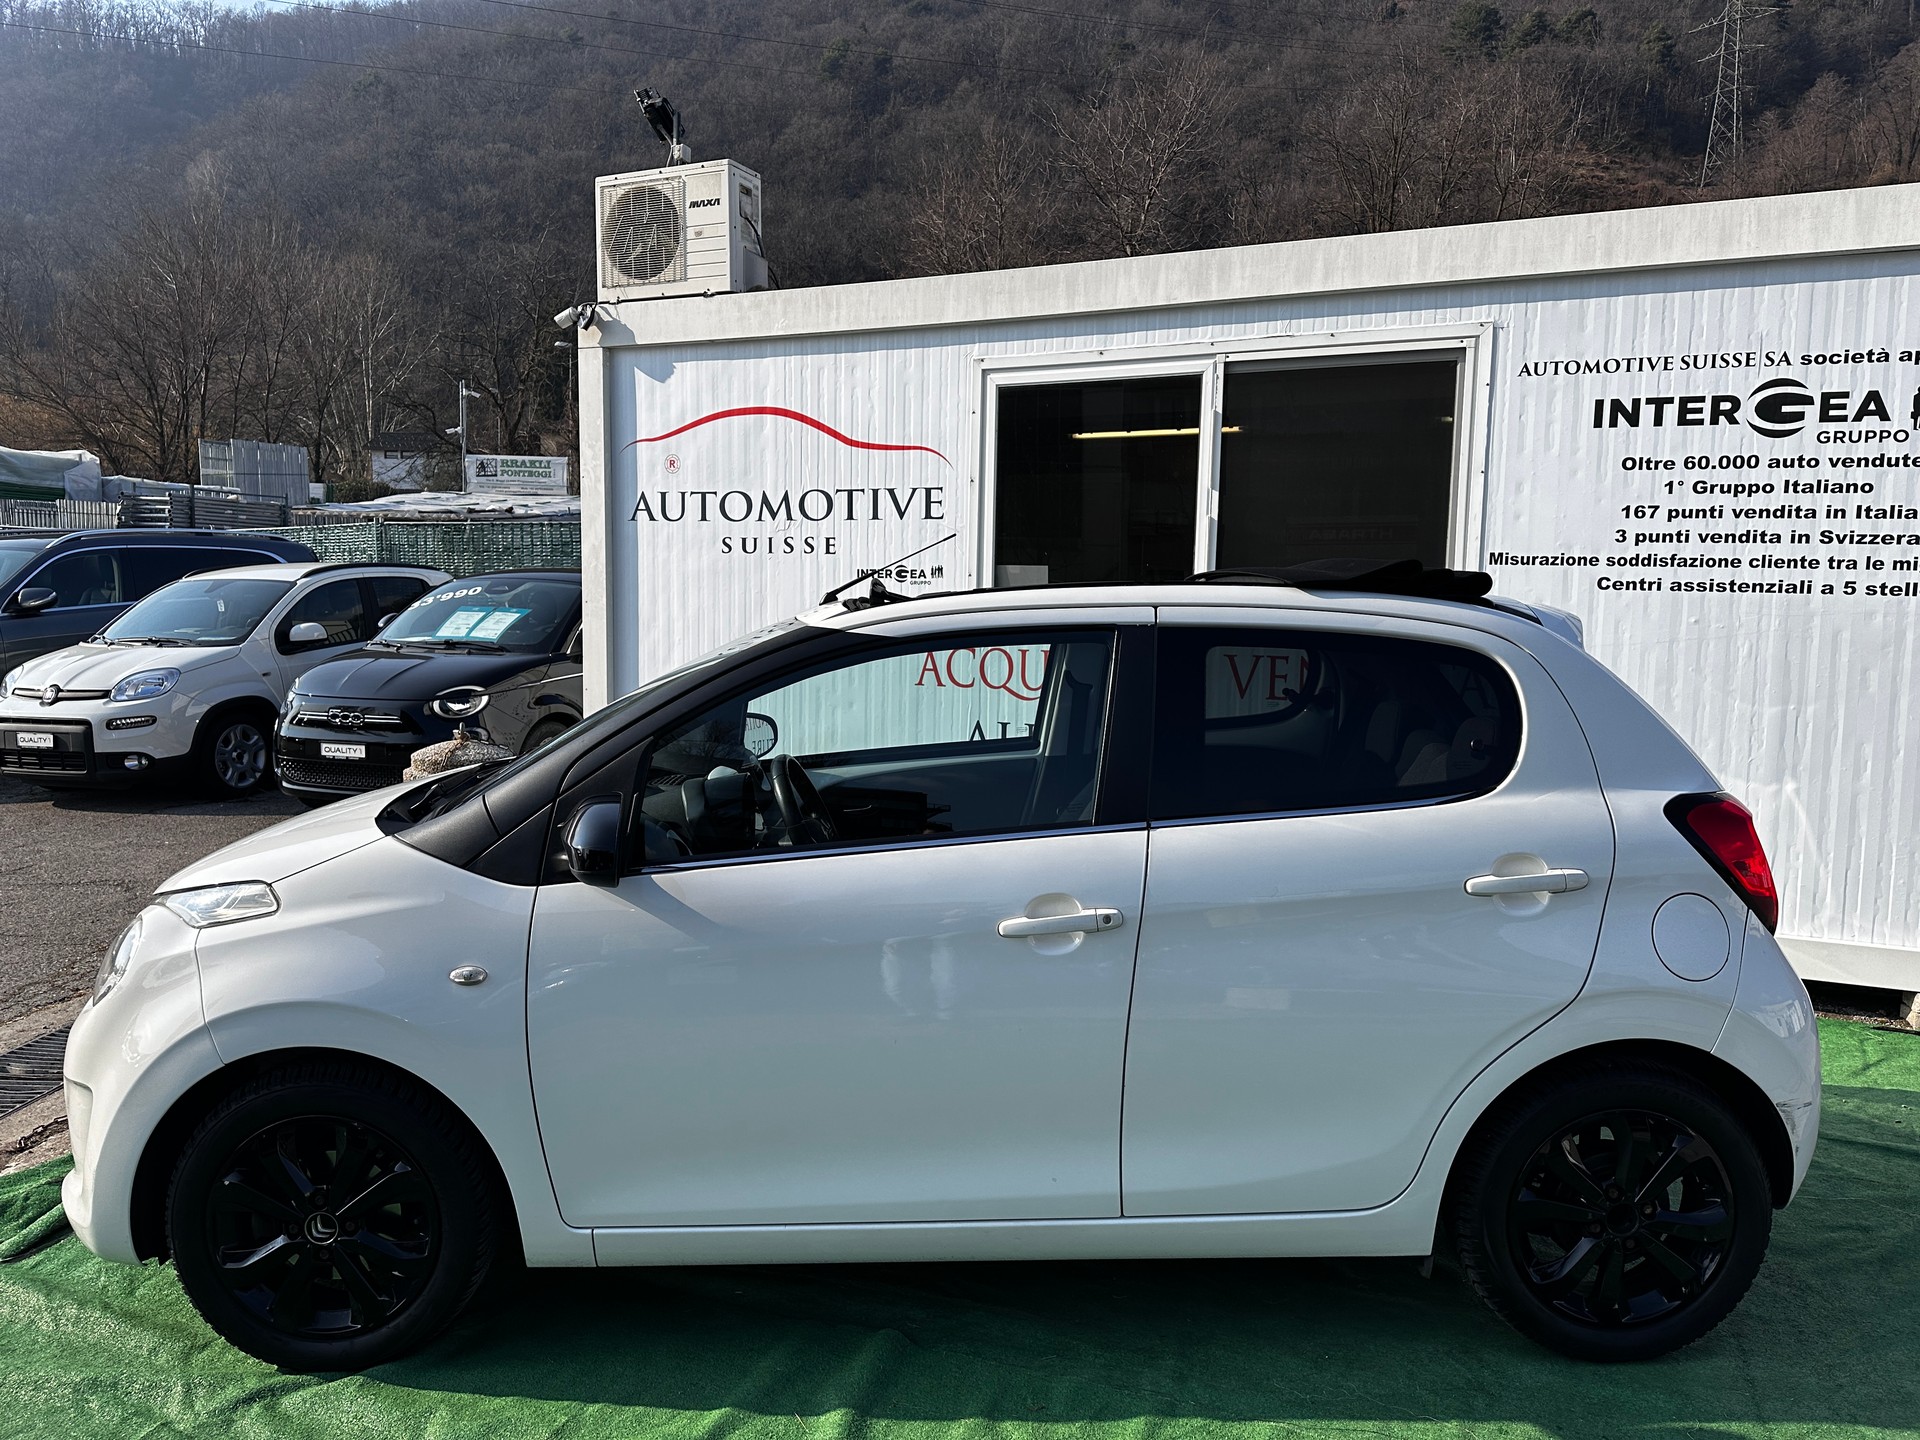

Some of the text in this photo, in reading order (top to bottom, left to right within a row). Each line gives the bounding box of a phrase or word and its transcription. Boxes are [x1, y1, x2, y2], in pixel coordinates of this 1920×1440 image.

[688, 198, 721, 209] MAXA
[1517, 355, 1674, 377] AUTOMOTIVE
[1679, 351, 1757, 371] SUISSE
[1763, 350, 1793, 368] SA
[1800, 347, 1890, 366] società
[1593, 380, 1892, 438] INTERGEA
[1816, 429, 1910, 444] GRUPPO
[500, 459, 552, 469] RRAKLI
[1621, 453, 1920, 471] Oltre 60.000 auto vendute
[500, 469, 552, 478] PONTEGGI
[1664, 479, 1875, 498] 1° Gruppo Italiano
[627, 486, 946, 523] AUTOMOTIVE
[1620, 504, 1918, 523] 167 punti vendita in Italia
[721, 536, 837, 555] SUISSE
[1614, 529, 1920, 547] 3 punti vendita in Svizzera
[1488, 552, 1920, 573] Misurazione soddisfazione cliente tra le mi
[1596, 576, 1920, 597] Centri assistenziali a 5 stell
[408, 586, 483, 610] 33'990
[324, 746, 357, 754] QUALITY
